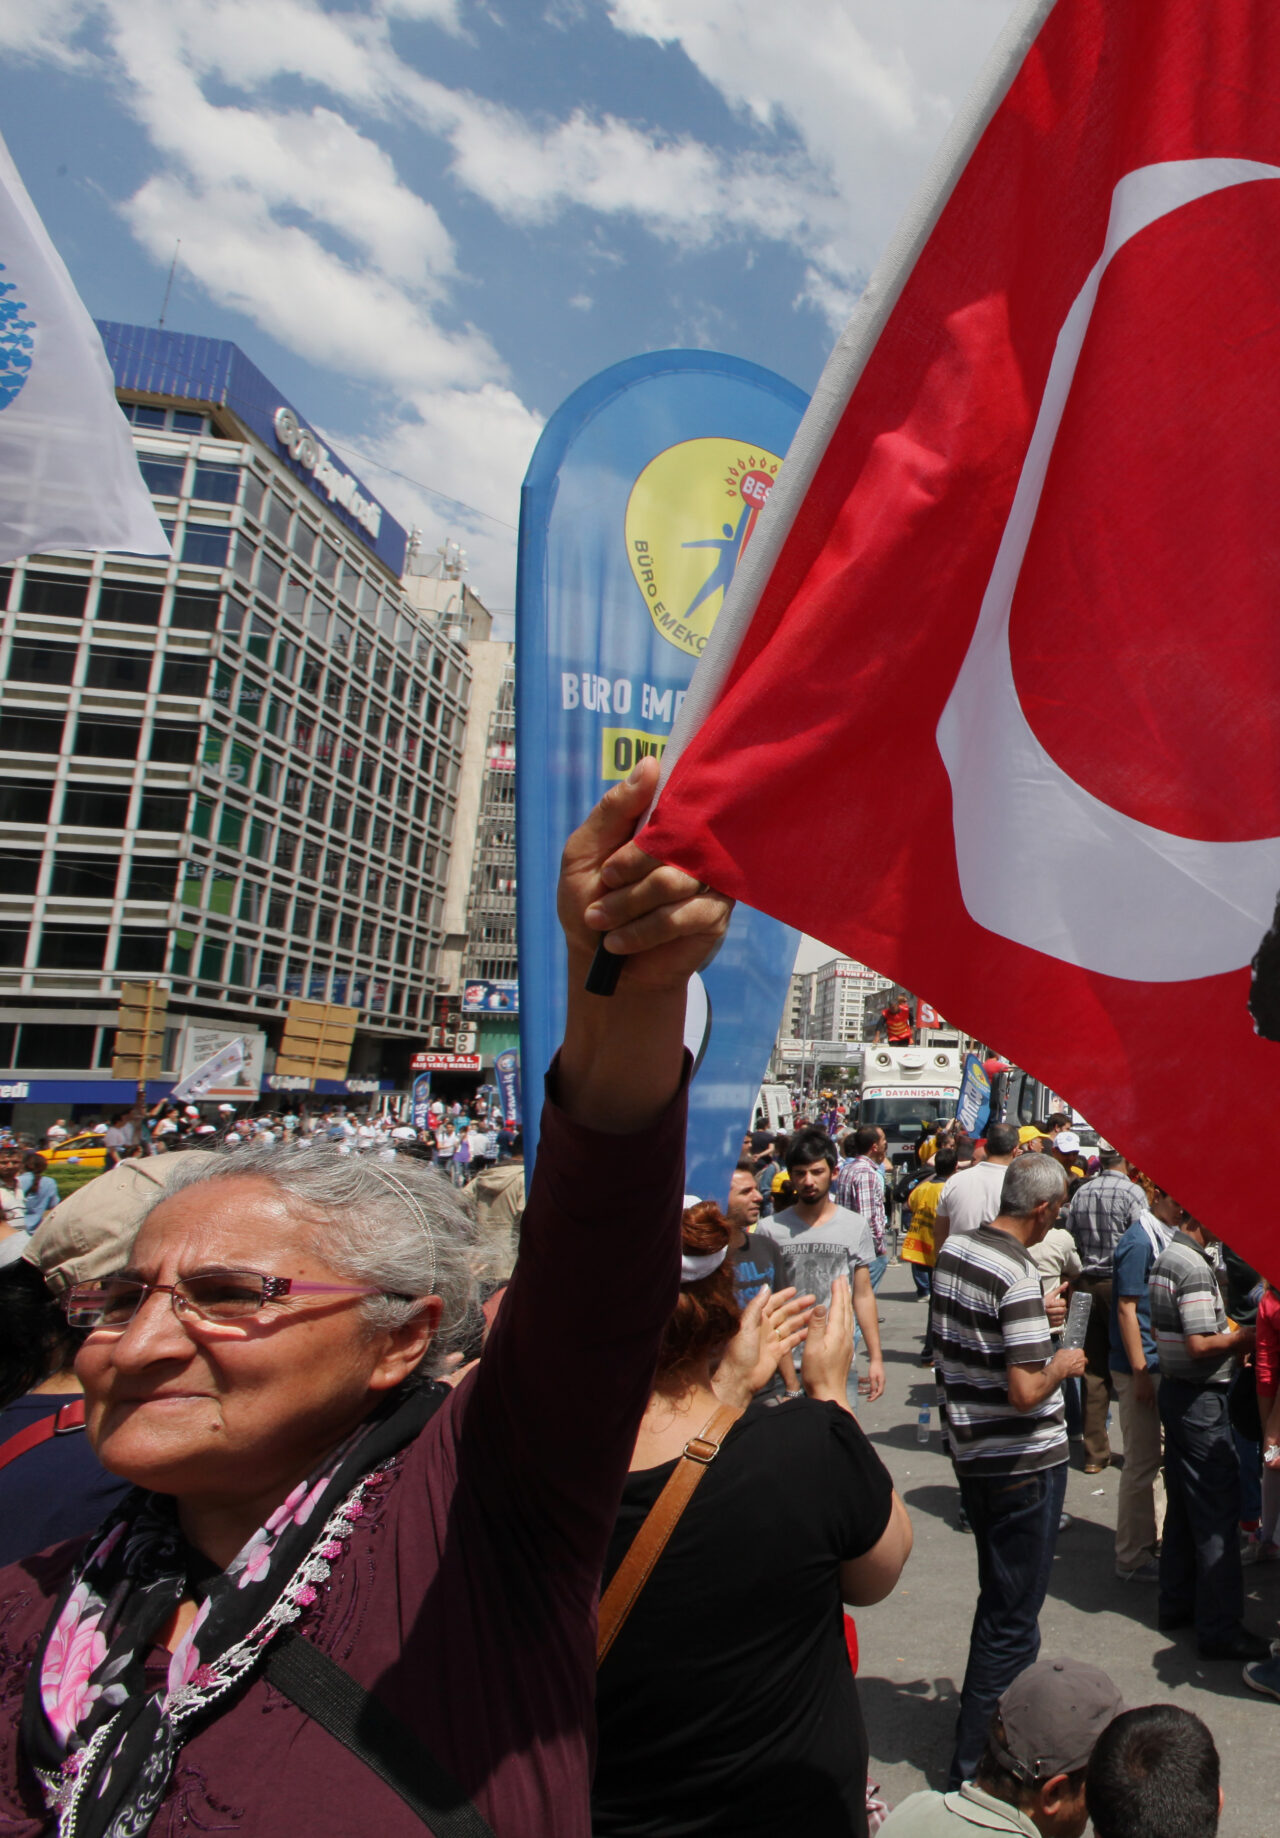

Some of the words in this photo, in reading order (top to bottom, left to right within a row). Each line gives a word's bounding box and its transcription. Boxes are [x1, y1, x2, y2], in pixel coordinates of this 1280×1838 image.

[633, 540, 657, 598] BÜRO
[652, 601, 708, 654] EMEKÇ
[561, 672, 632, 715] BÜRO
[417, 1055, 475, 1063] SOYSAL
